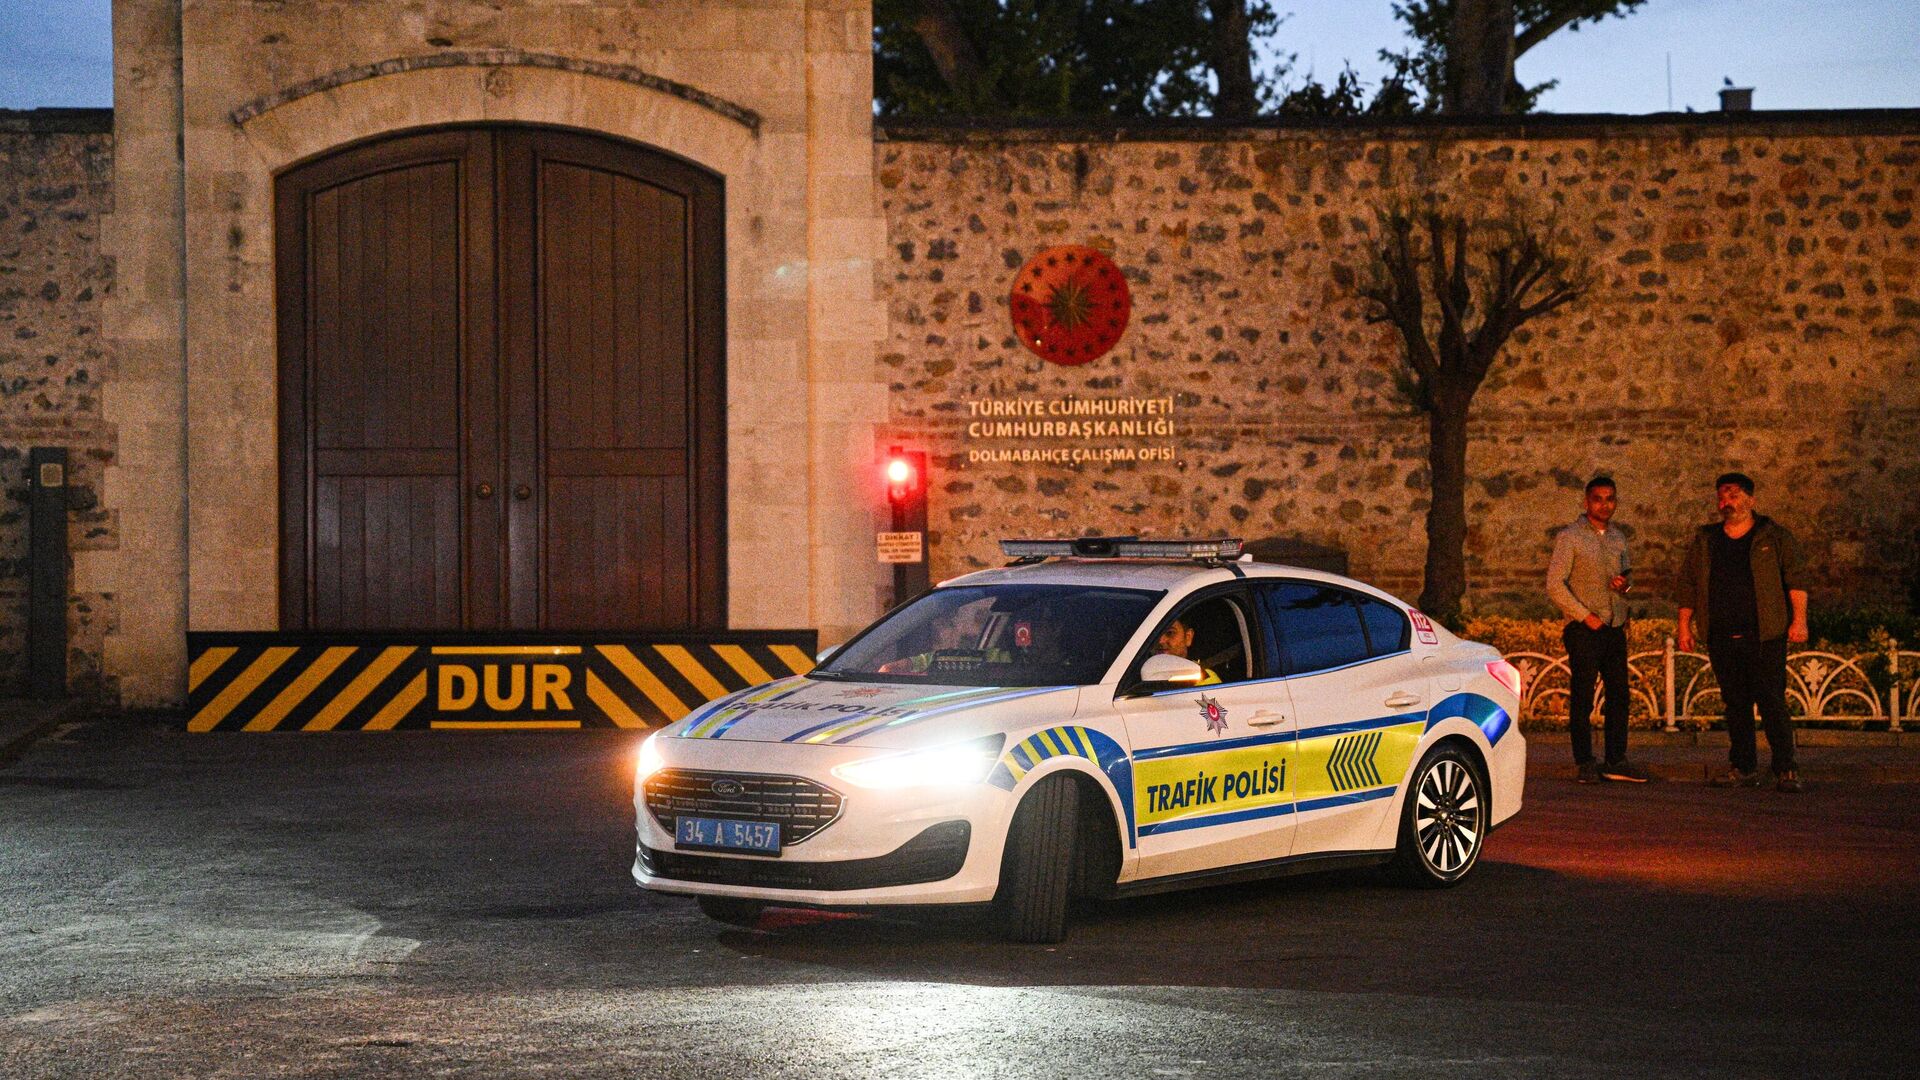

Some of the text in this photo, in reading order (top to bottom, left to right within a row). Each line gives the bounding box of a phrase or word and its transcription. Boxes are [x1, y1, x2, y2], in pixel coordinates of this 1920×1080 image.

[969, 396, 1174, 416] TÜRKİYE CUMHURİYETİ
[969, 418, 1174, 439] CUMHURBAŞKANLIĞI
[969, 446, 1175, 464] DOLMABAHÇE ÇALIŞMA OFİSİ
[1411, 612, 1431, 629] 112
[438, 664, 574, 711] DUR
[718, 783, 736, 794] Ford
[1147, 758, 1286, 813] TRAFİK POLİSİ
[685, 821, 774, 848] 34 A 5457
